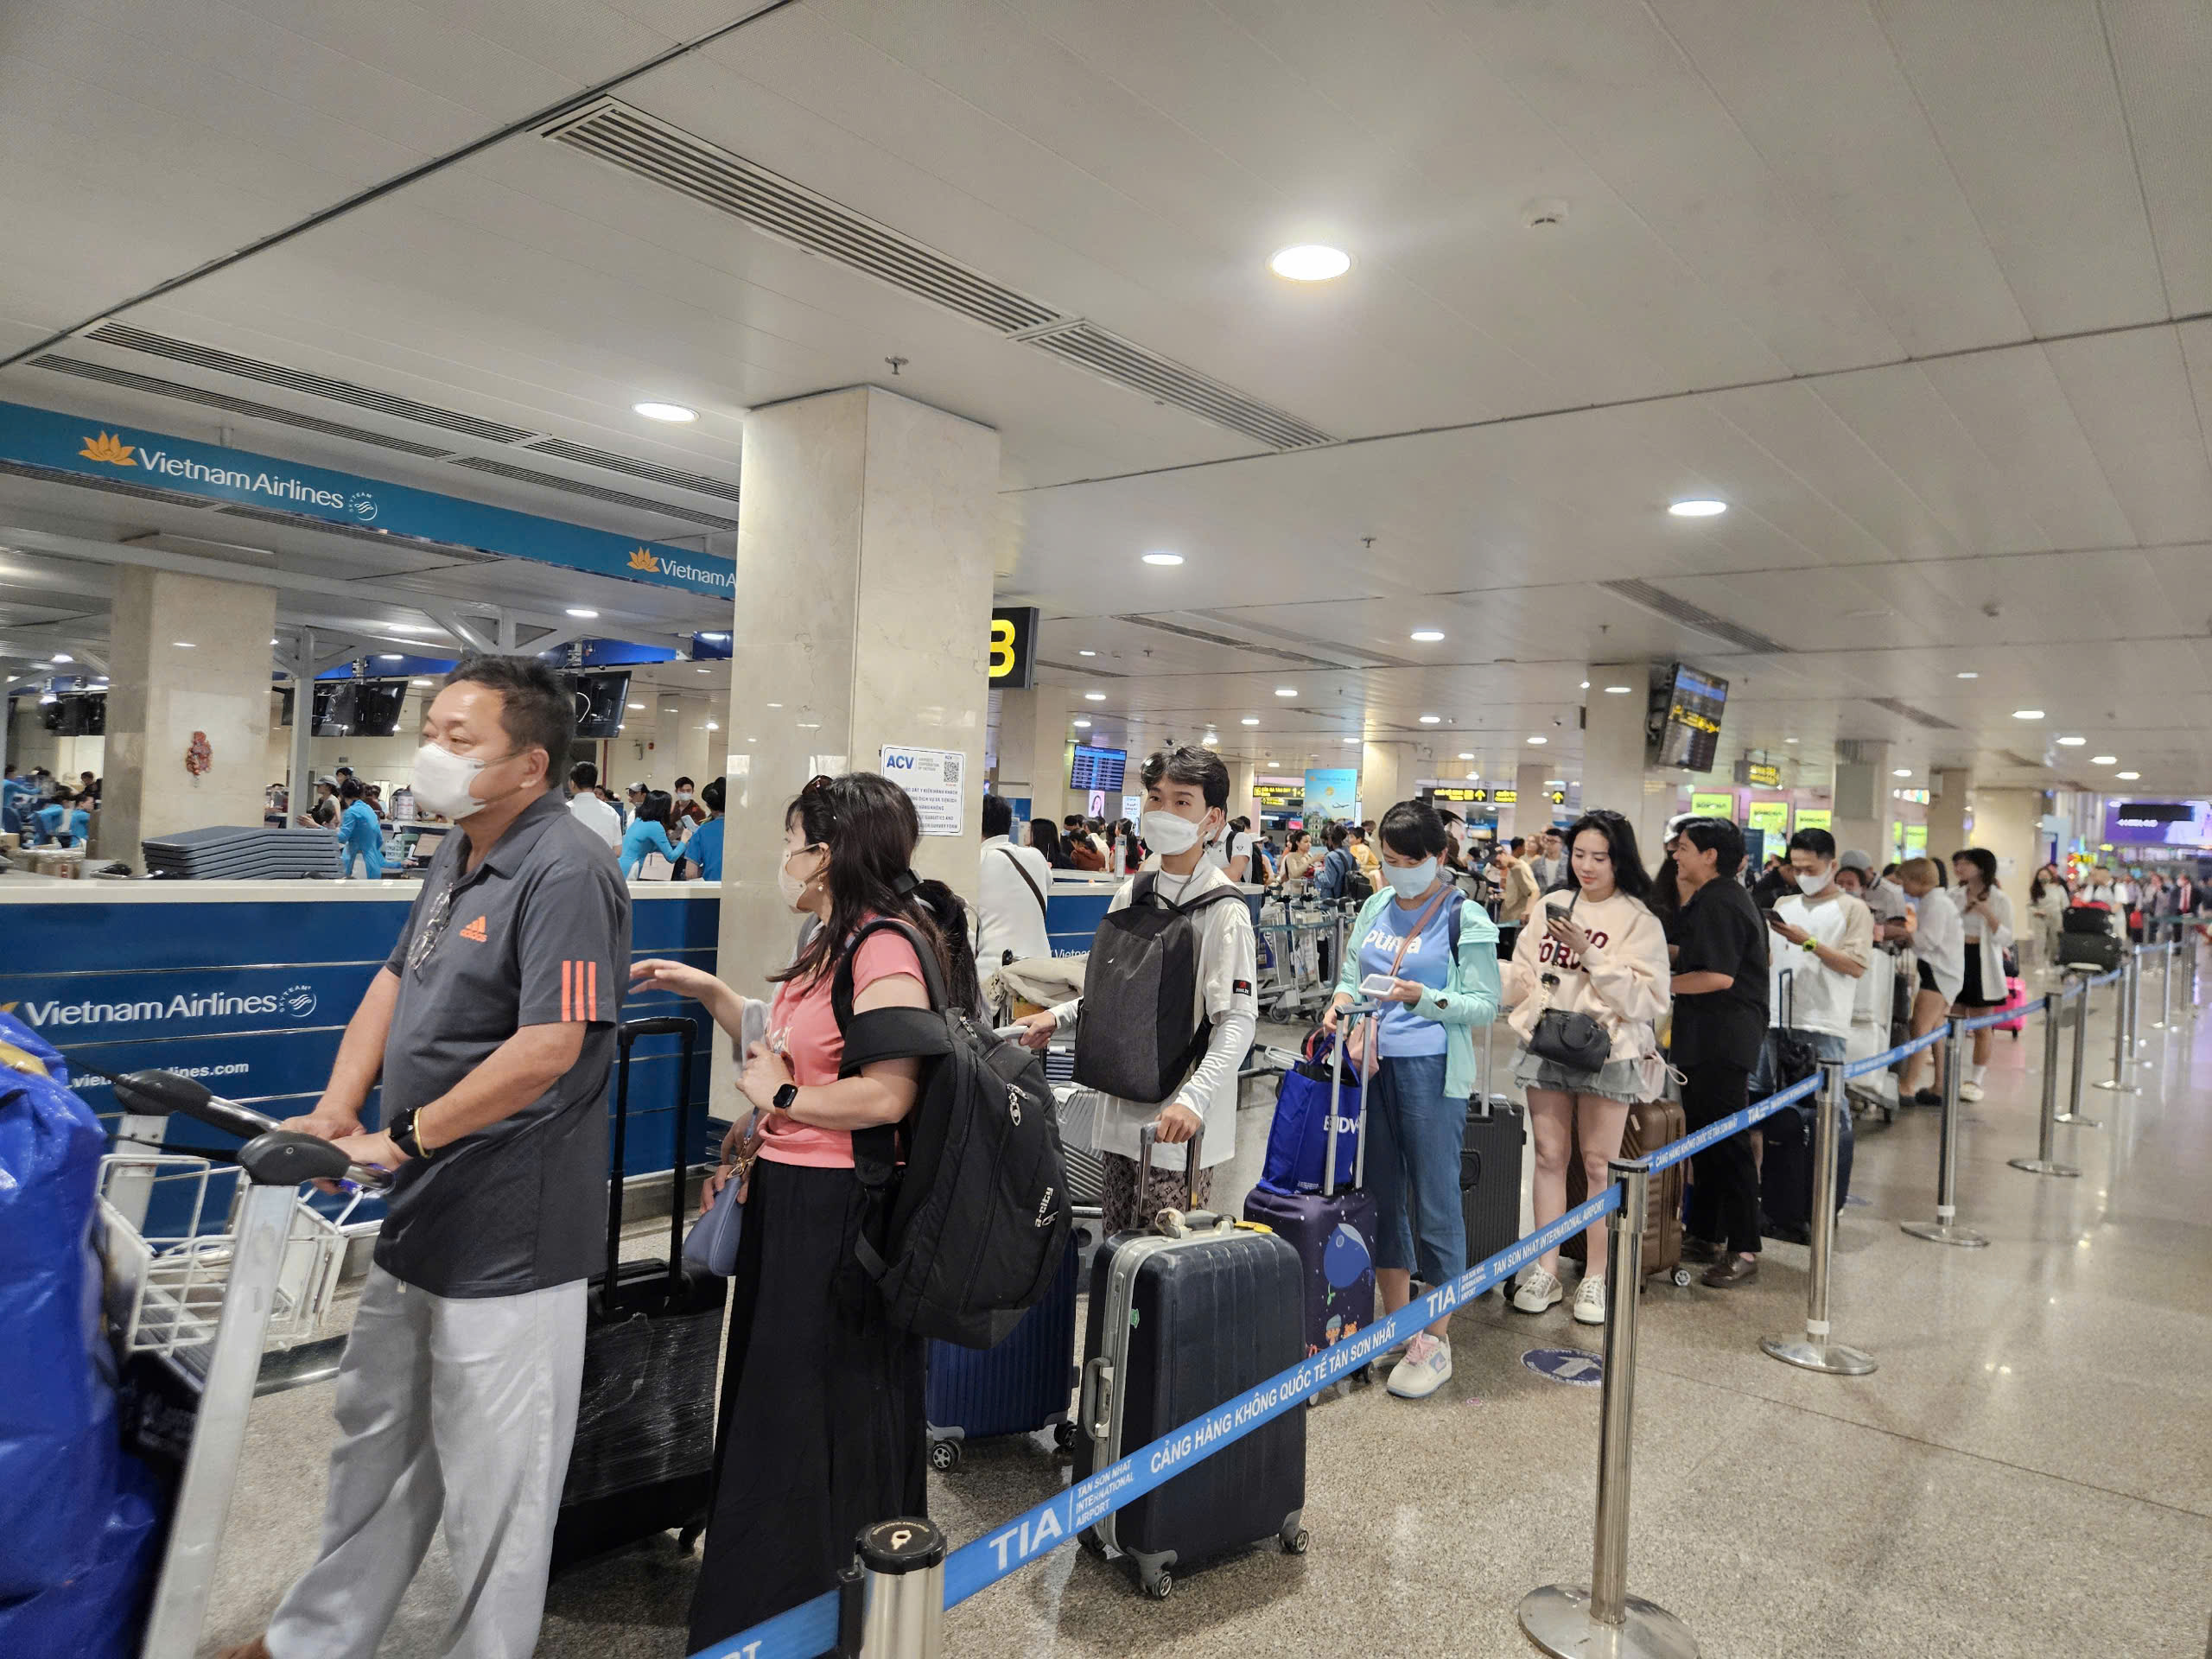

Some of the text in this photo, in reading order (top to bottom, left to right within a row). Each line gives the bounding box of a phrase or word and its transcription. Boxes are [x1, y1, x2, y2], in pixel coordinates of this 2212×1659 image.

[138, 448, 344, 509] Vietnam Airlines
[348, 491, 373, 513] SKYTEAM
[660, 557, 725, 587] Vietnam
[887, 754, 914, 770] ACV
[460, 929, 487, 943] adidas
[1361, 929, 1422, 955] puma
[24, 992, 277, 1027] Vietnam Airlines
[278, 985, 312, 1013] SKYTEAM
[1035, 1186, 1054, 1228] a-city
[1493, 1198, 1605, 1276] TAN SON NHAT INTERNATIONAL AIRPORT
[1460, 1273, 1487, 1292] INTERNATIONAL
[1460, 1287, 1477, 1302] AIRPORT
[1427, 1284, 1456, 1319] TIA
[1150, 1318, 1397, 1474] CẢNG HÀNG KHÔNG QUỐC TẾ TÂN SƠN NHẤT
[1076, 1471, 1135, 1515] INTERNATIONAL
[1077, 1459, 1133, 1499] TAN SON NHAT
[1076, 1498, 1111, 1529] AIRPORT
[988, 1507, 1064, 1570] TIA
